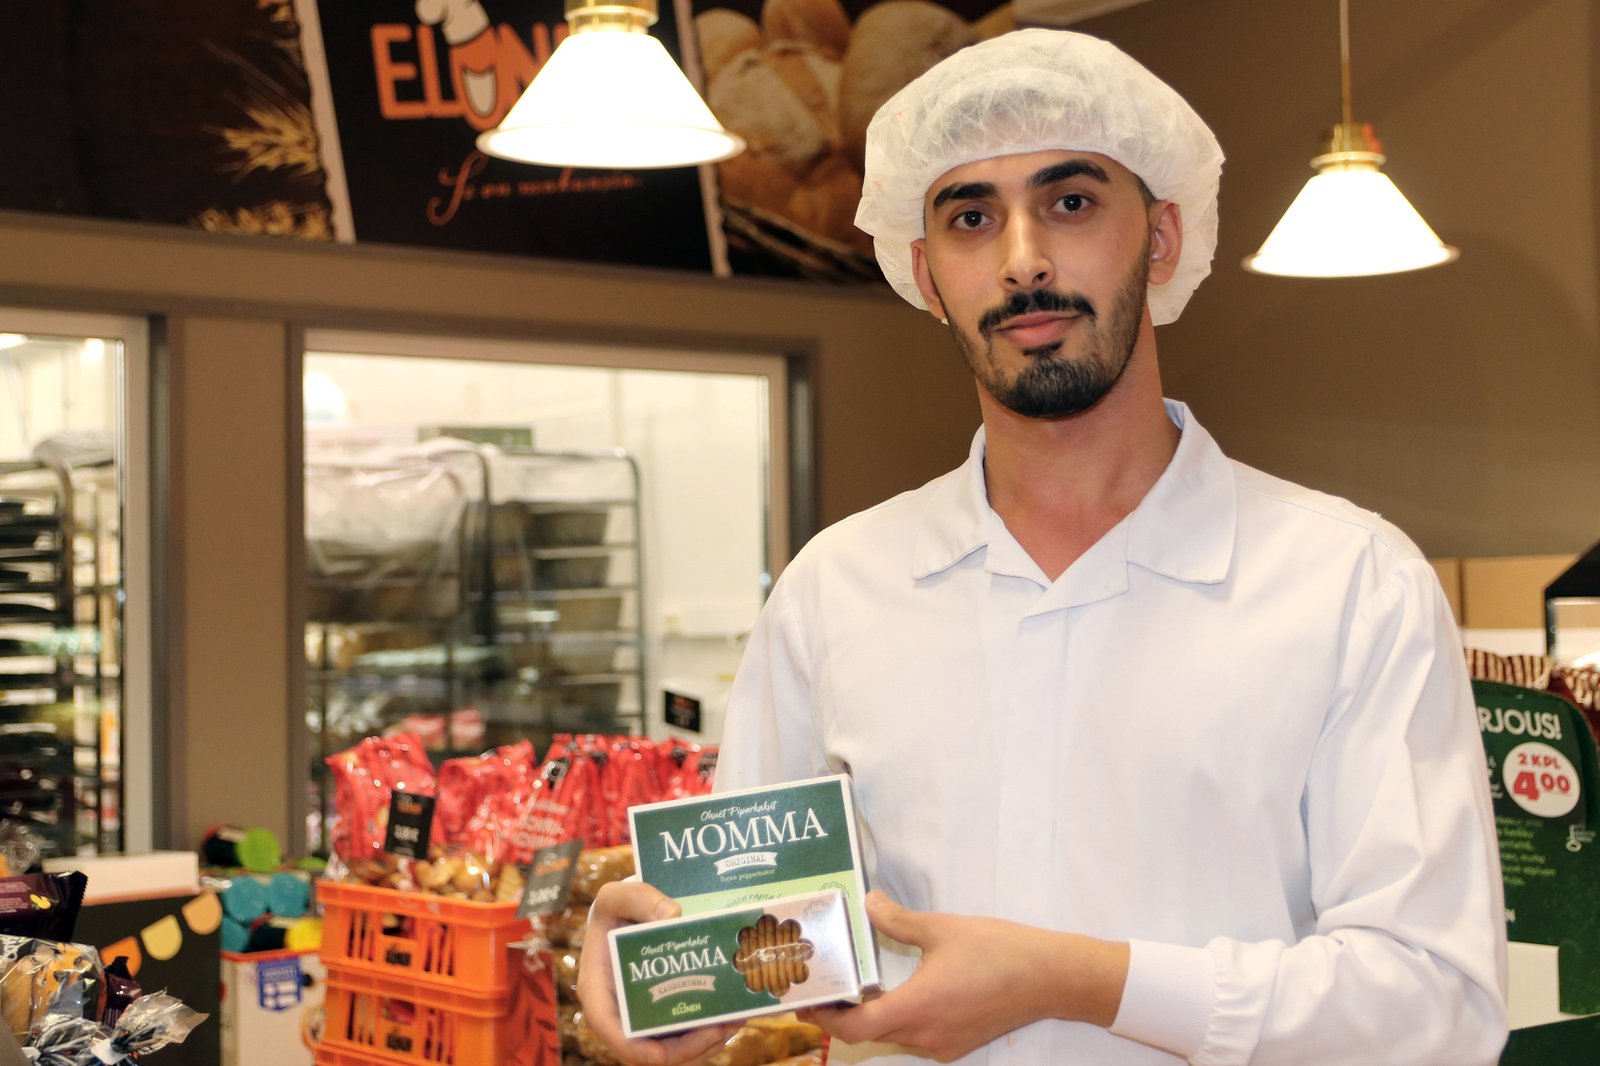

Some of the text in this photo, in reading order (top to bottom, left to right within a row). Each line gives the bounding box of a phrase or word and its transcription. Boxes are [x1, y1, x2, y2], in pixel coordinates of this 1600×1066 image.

[1477, 706, 1563, 741] RJOUS!
[1518, 753, 1527, 765] 2
[700, 800, 778, 822] Ohuet Piparkakut
[659, 807, 829, 863] MOMMA
[725, 854, 767, 868] ORIGINAL
[628, 945, 729, 982] MOMMA
[671, 1002, 702, 1016] ELONEN
